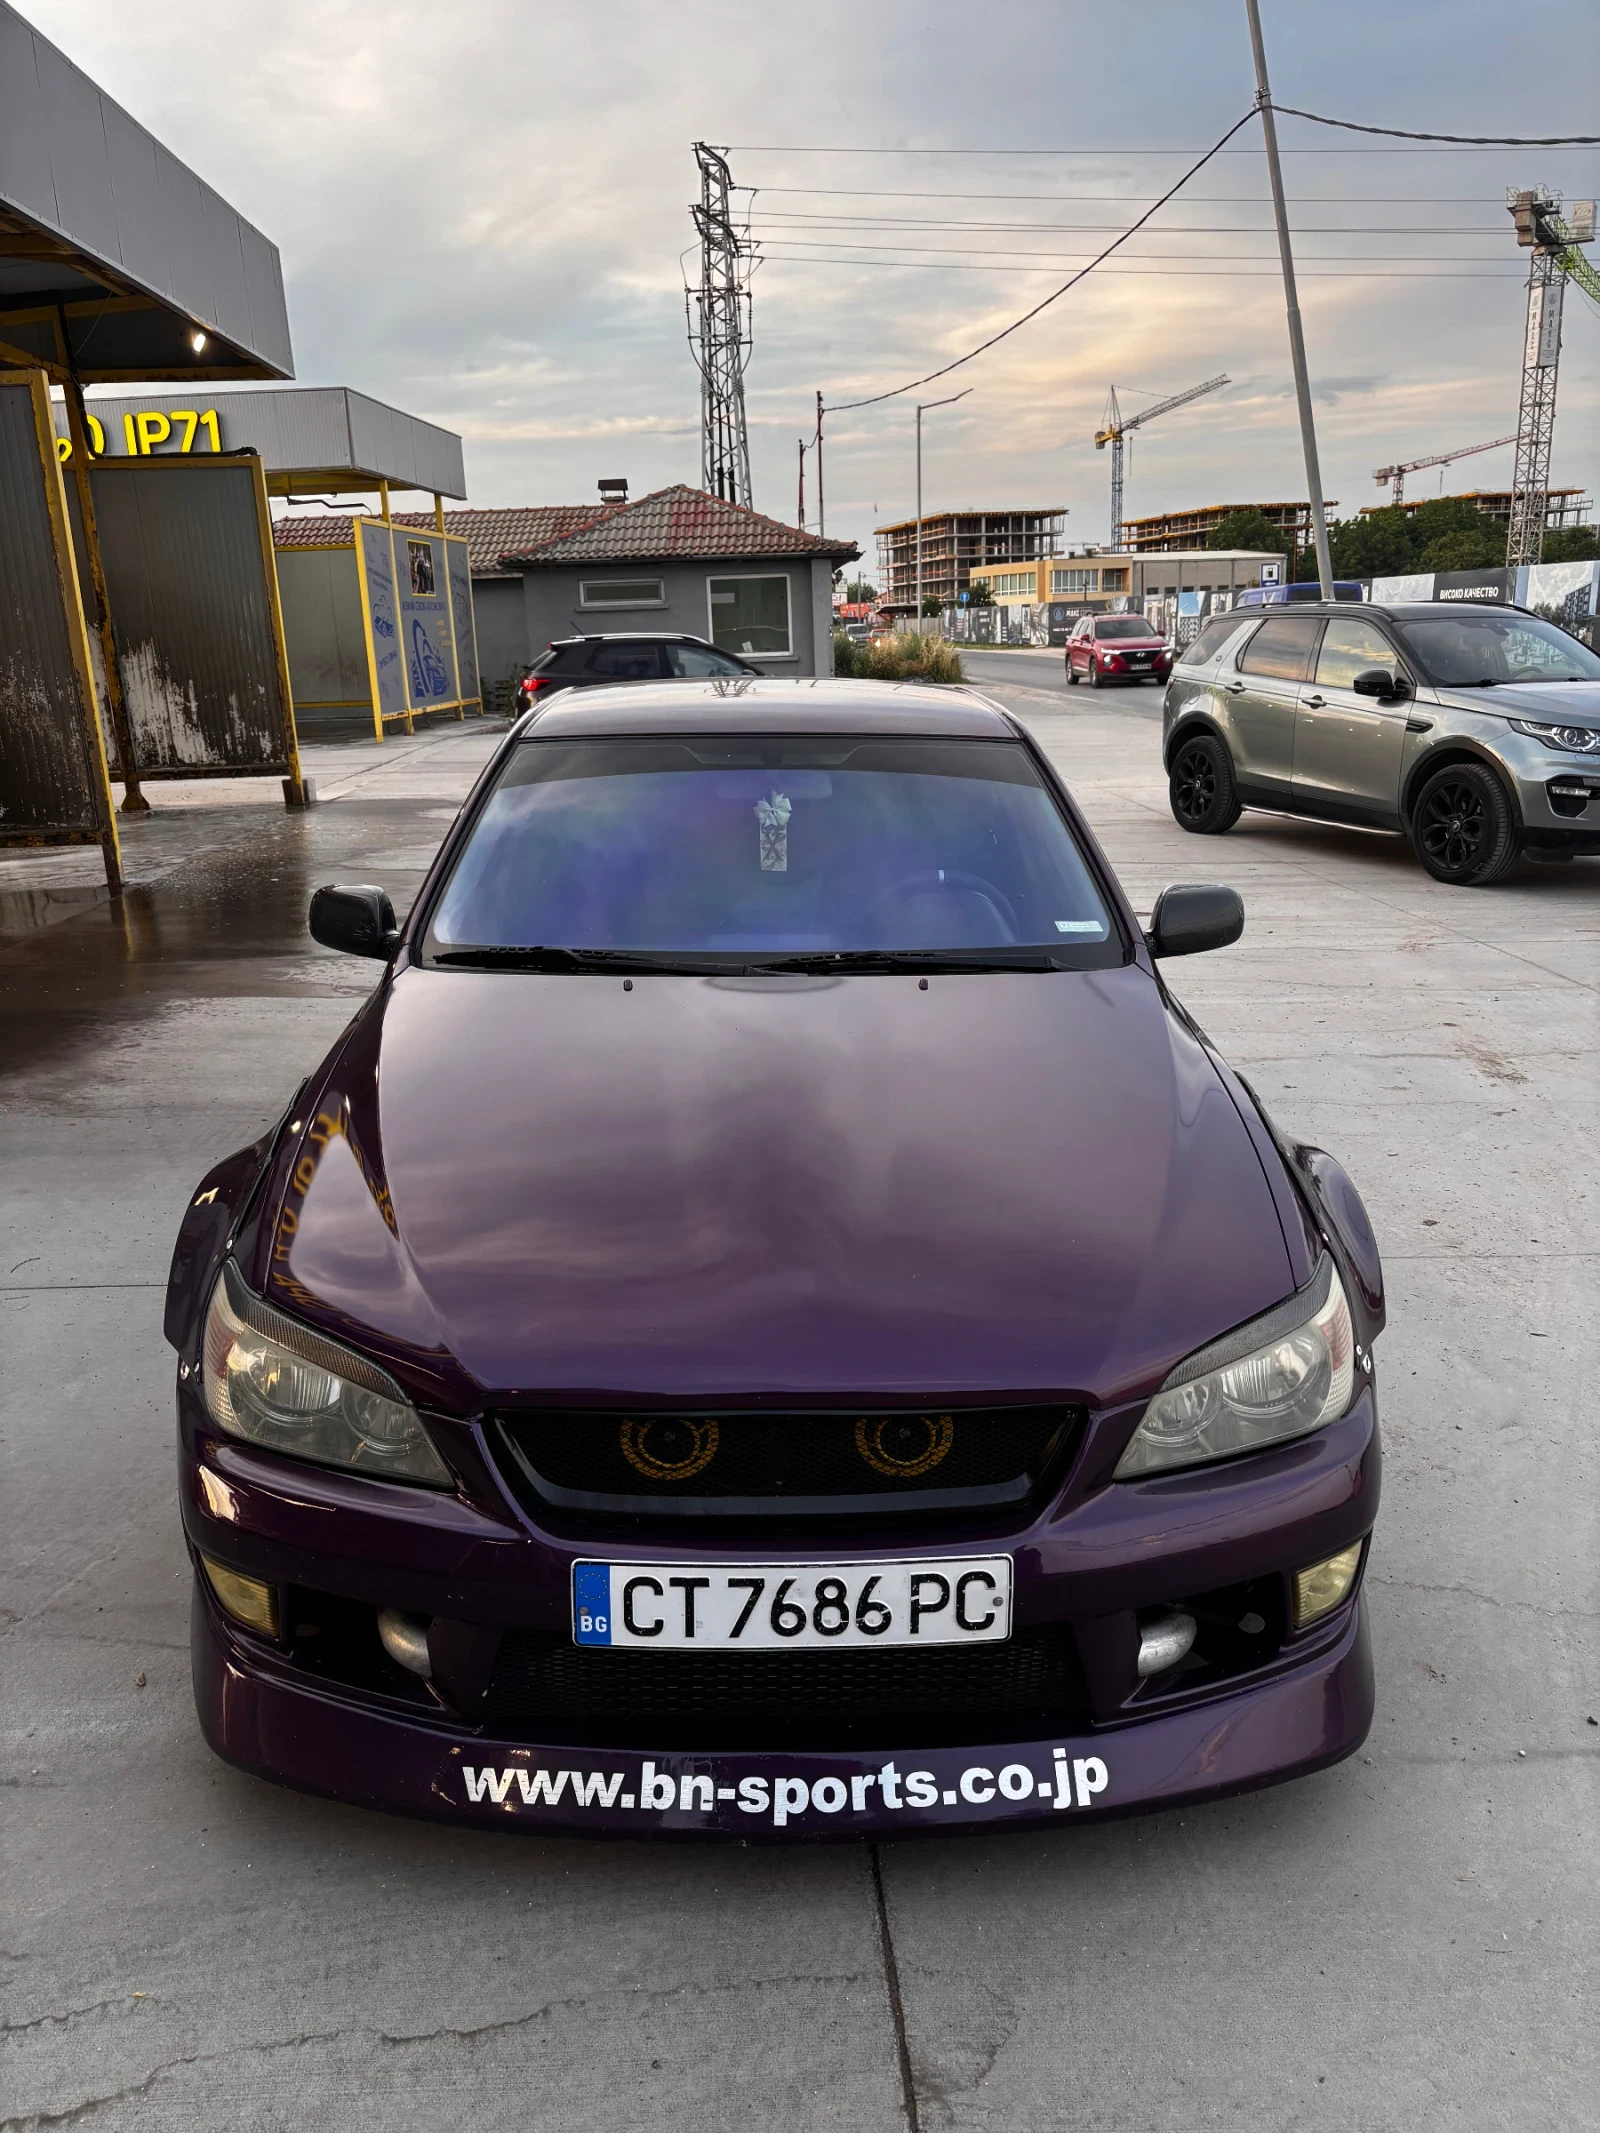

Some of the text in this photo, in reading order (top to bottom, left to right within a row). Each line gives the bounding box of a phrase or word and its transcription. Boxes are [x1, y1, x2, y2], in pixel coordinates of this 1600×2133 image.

[123, 409, 221, 456] IP71
[1439, 586, 1499, 600] ВИСОКО КАЧЕСТВО
[580, 1570, 996, 1638] BG CT 7686 PC
[462, 1748, 1109, 1826] www.bn-sports.co.jp
